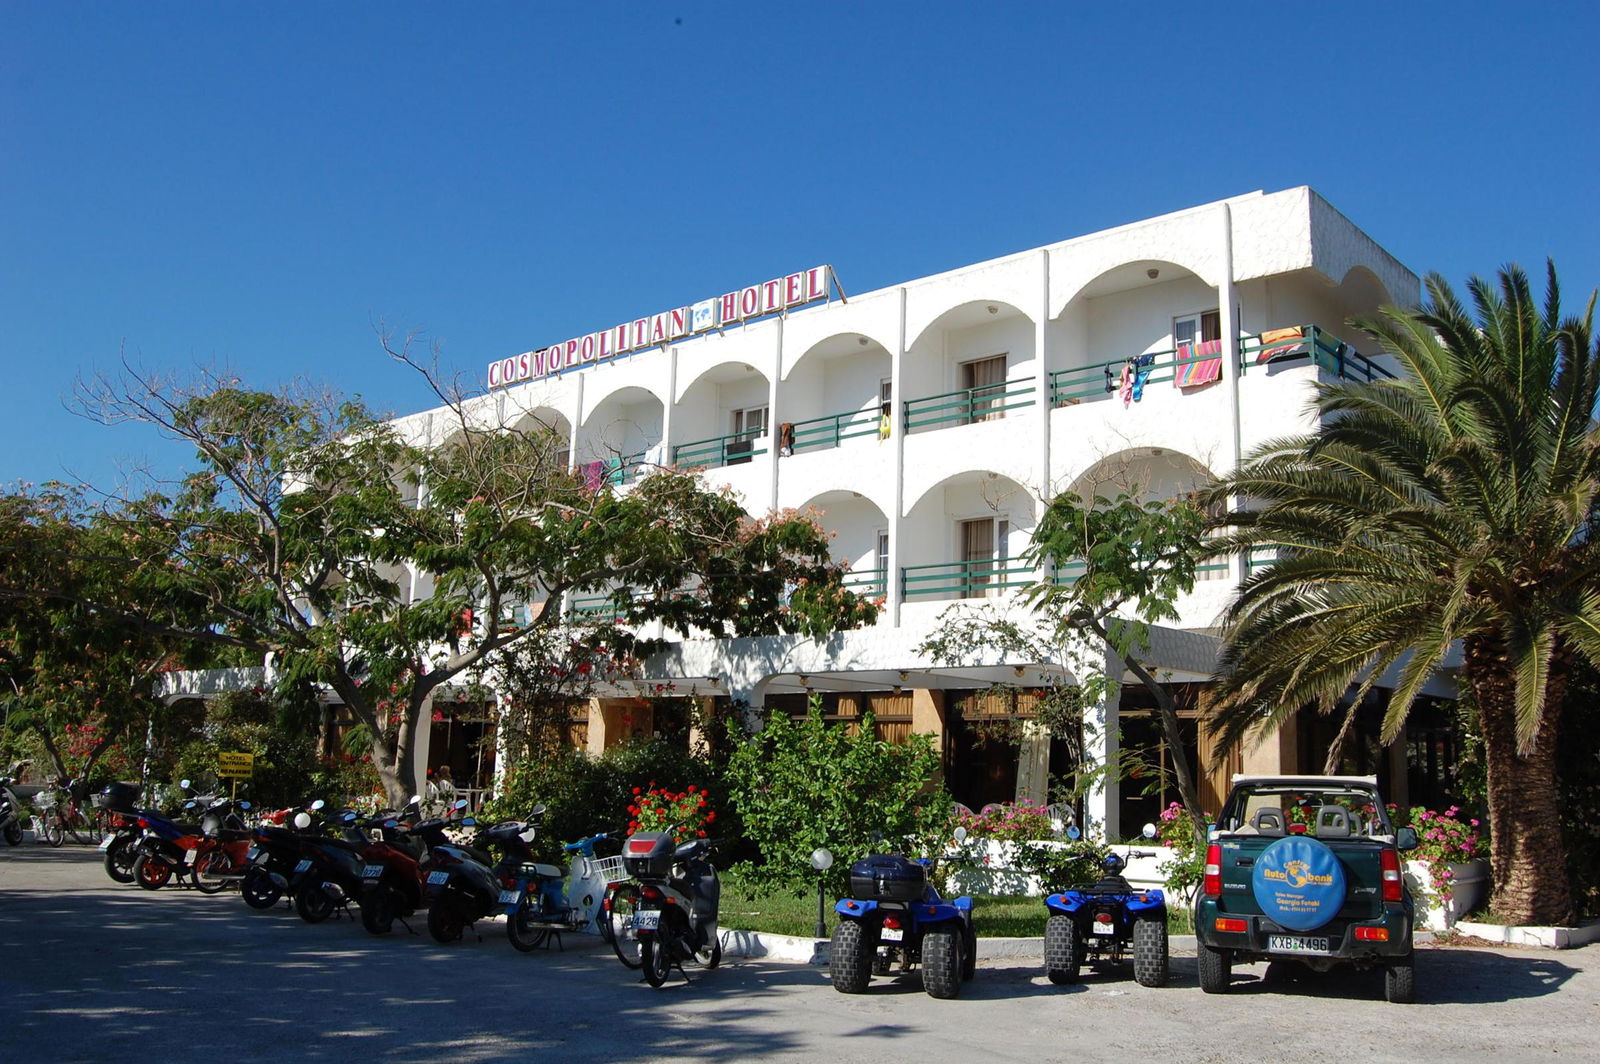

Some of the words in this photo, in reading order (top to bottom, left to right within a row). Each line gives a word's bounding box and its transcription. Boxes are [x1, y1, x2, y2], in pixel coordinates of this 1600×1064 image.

[488, 307, 686, 386] COSMOPOLITAN
[722, 268, 824, 322] HOTEL
[1264, 869, 1286, 879] Auto
[1308, 873, 1332, 882] bank
